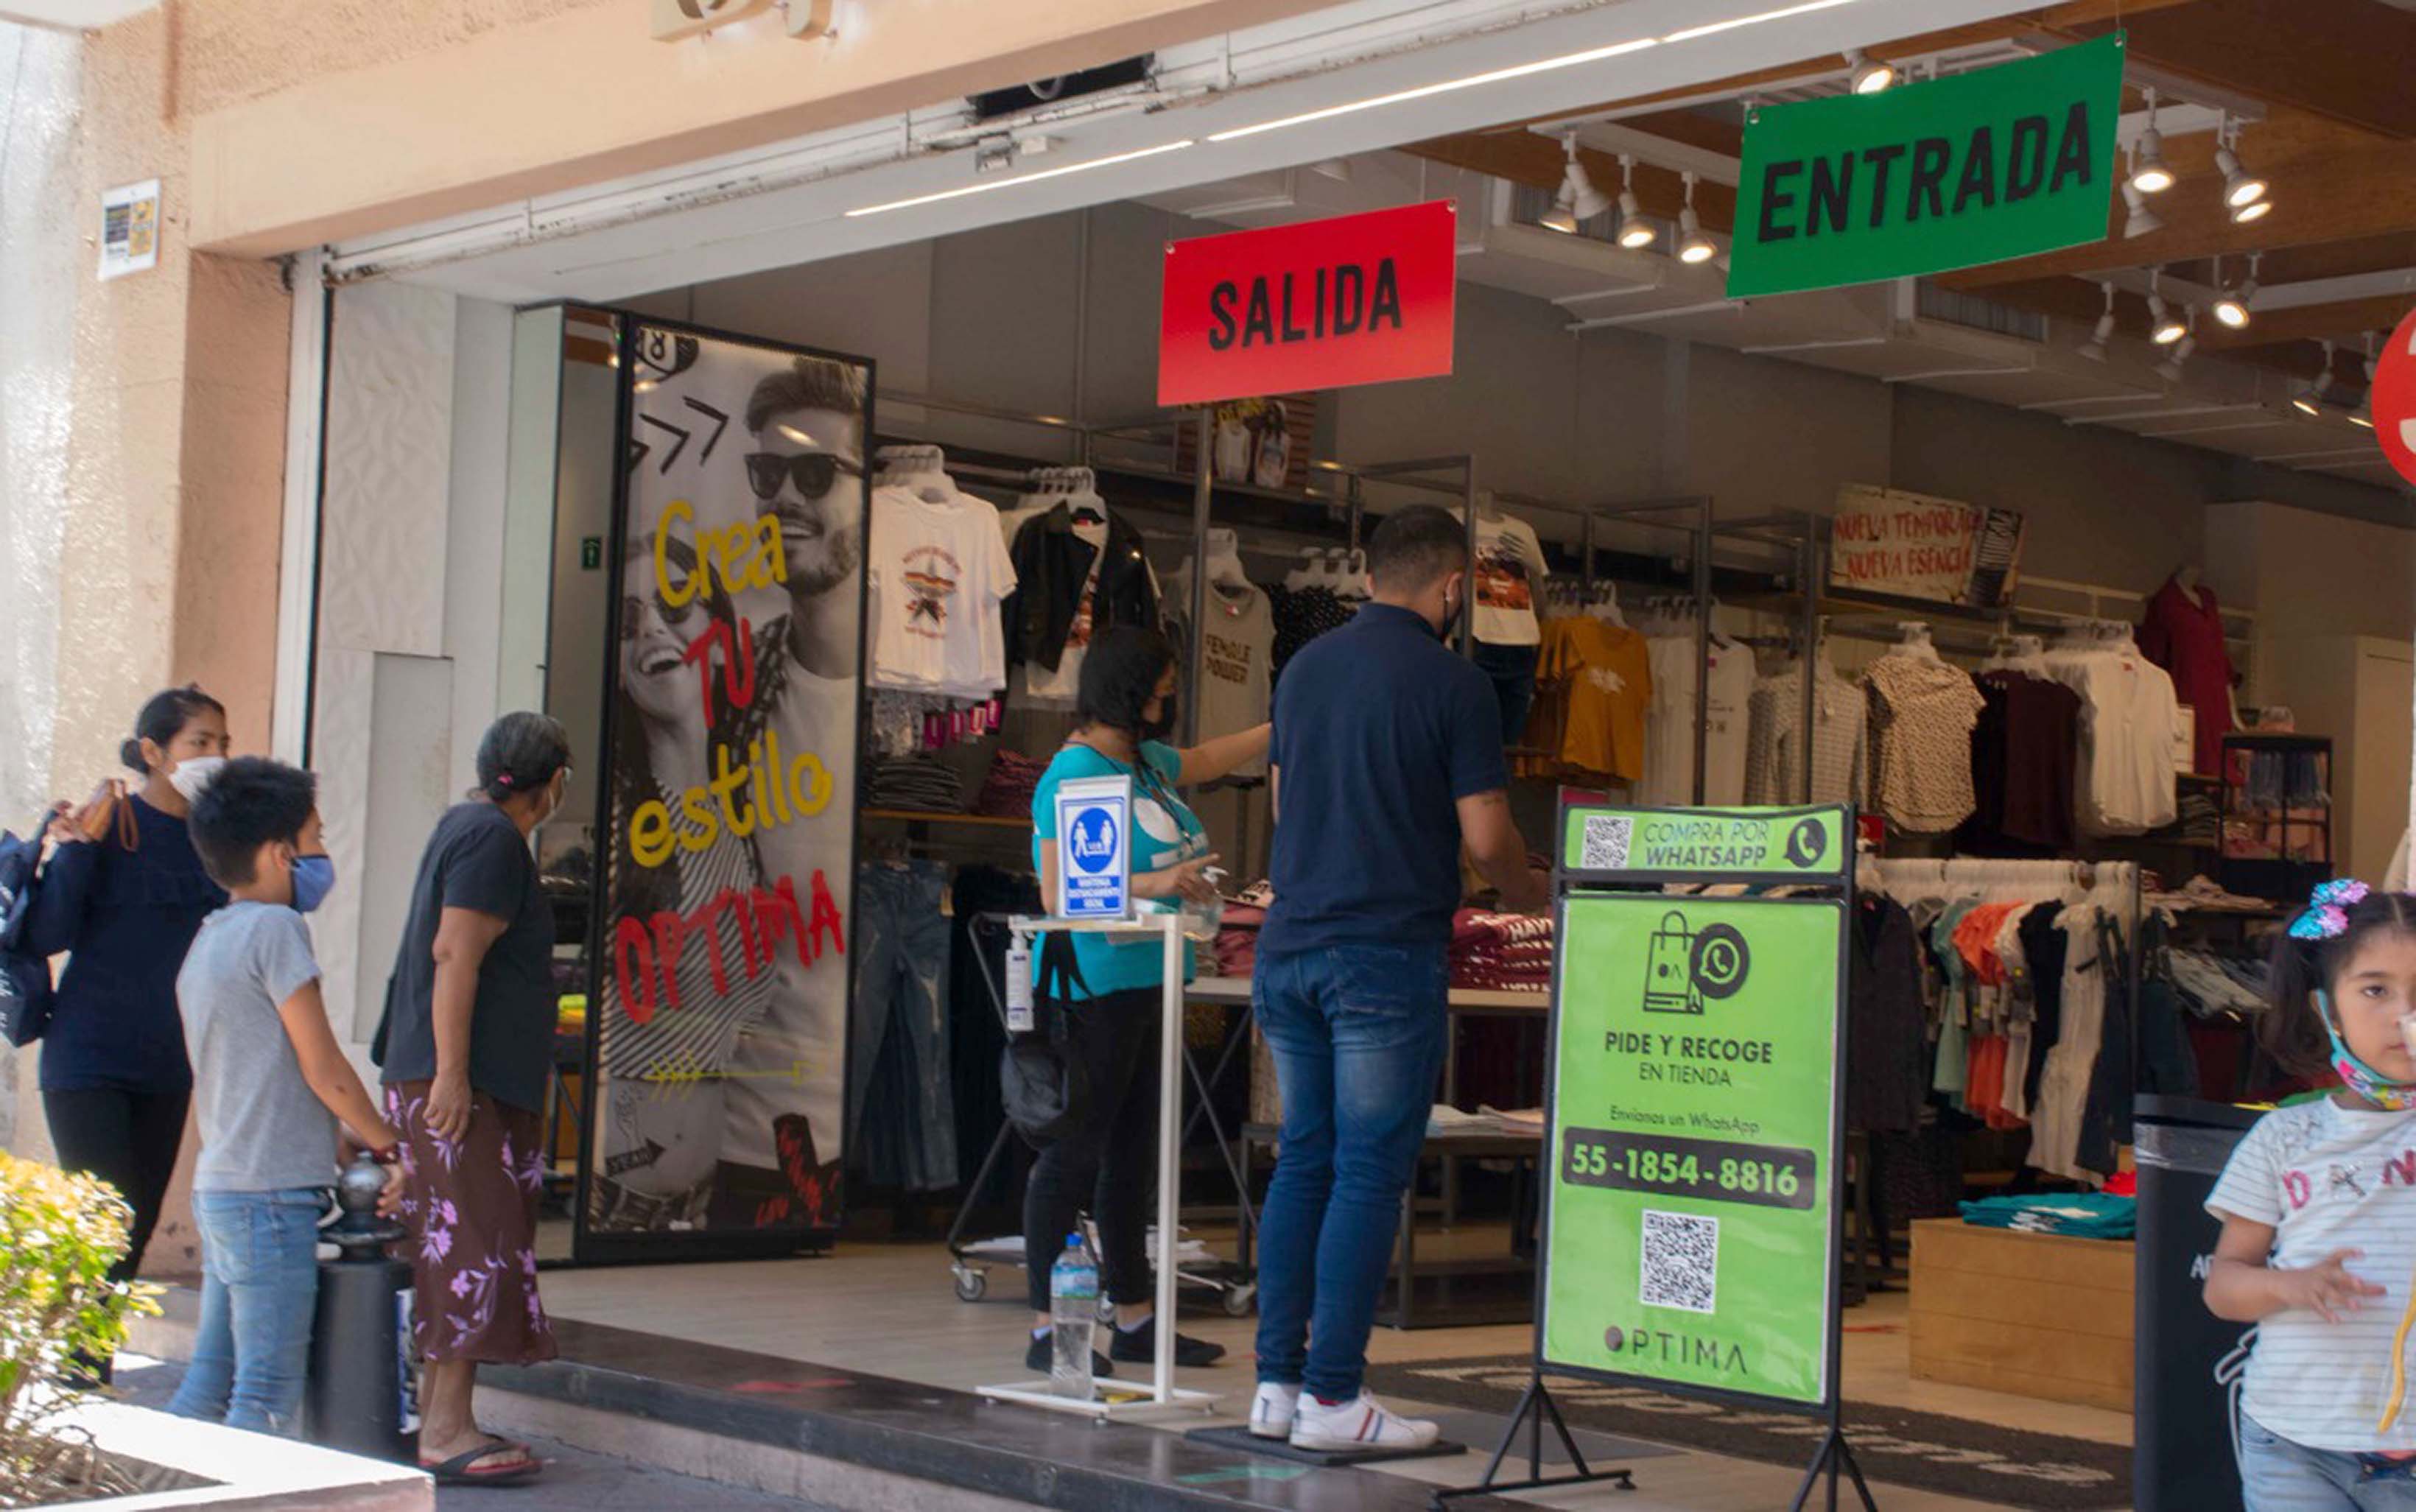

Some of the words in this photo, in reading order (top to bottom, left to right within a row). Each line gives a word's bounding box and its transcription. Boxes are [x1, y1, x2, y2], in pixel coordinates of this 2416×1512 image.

[1757, 100, 2091, 244] ENTRADA
[1208, 257, 1402, 351] SALIDA
[654, 500, 788, 608] Crea
[1846, 549, 1903, 582] NUEVA
[1206, 633, 1251, 664] FEMALE
[684, 616, 755, 730] TU
[1205, 655, 1249, 686] POWER
[628, 728, 835, 869] estilo
[1643, 821, 1724, 845] COMPRA
[1730, 820, 1768, 843] POR
[1646, 845, 1766, 868] WHATSAPP
[616, 868, 845, 1025] OPTIMA
[1604, 1031, 1651, 1055] PIDE
[1660, 1035, 1674, 1055] Y
[1680, 1037, 1773, 1065] RECOGE
[1638, 1063, 1662, 1081] EN
[1668, 1066, 1732, 1087] TIENDA
[1668, 1114, 1685, 1125] un
[1690, 1113, 1760, 1135] WhatsApp
[1604, 1325, 1749, 1376] OPTIMA
